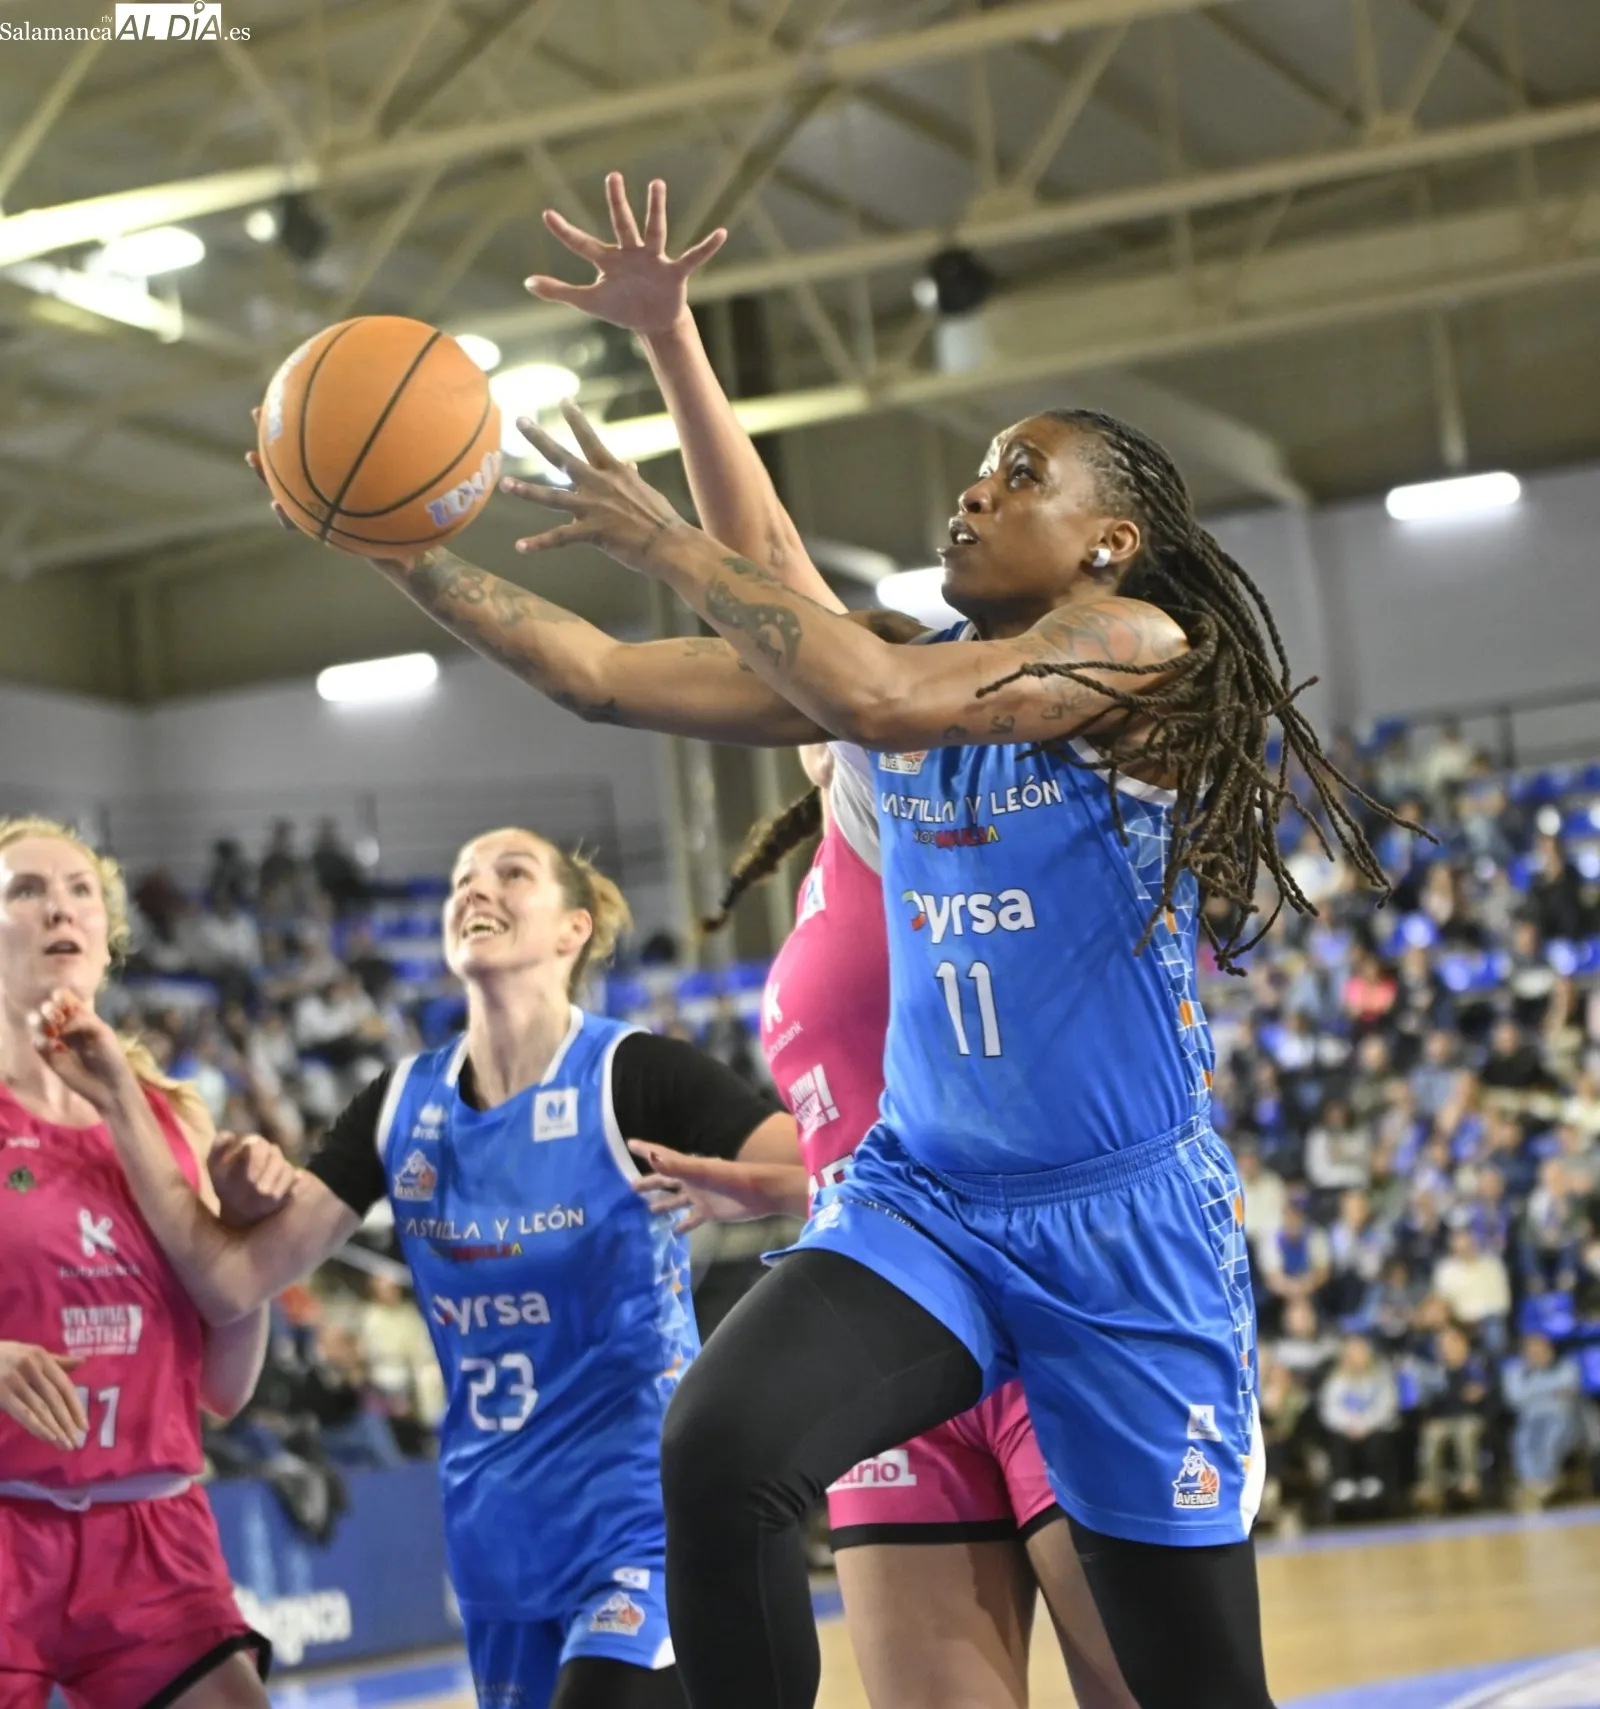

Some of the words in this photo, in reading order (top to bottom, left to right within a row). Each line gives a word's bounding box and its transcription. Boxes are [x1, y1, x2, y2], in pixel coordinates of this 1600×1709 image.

[966, 795, 981, 824] Y
[990, 775, 1063, 816] LEÓN
[935, 961, 1002, 1057] 11
[401, 1216, 482, 1240] ASTILLA
[495, 1217, 509, 1241] Y
[519, 1203, 585, 1235] LEÓN
[460, 1353, 539, 1431] 23
